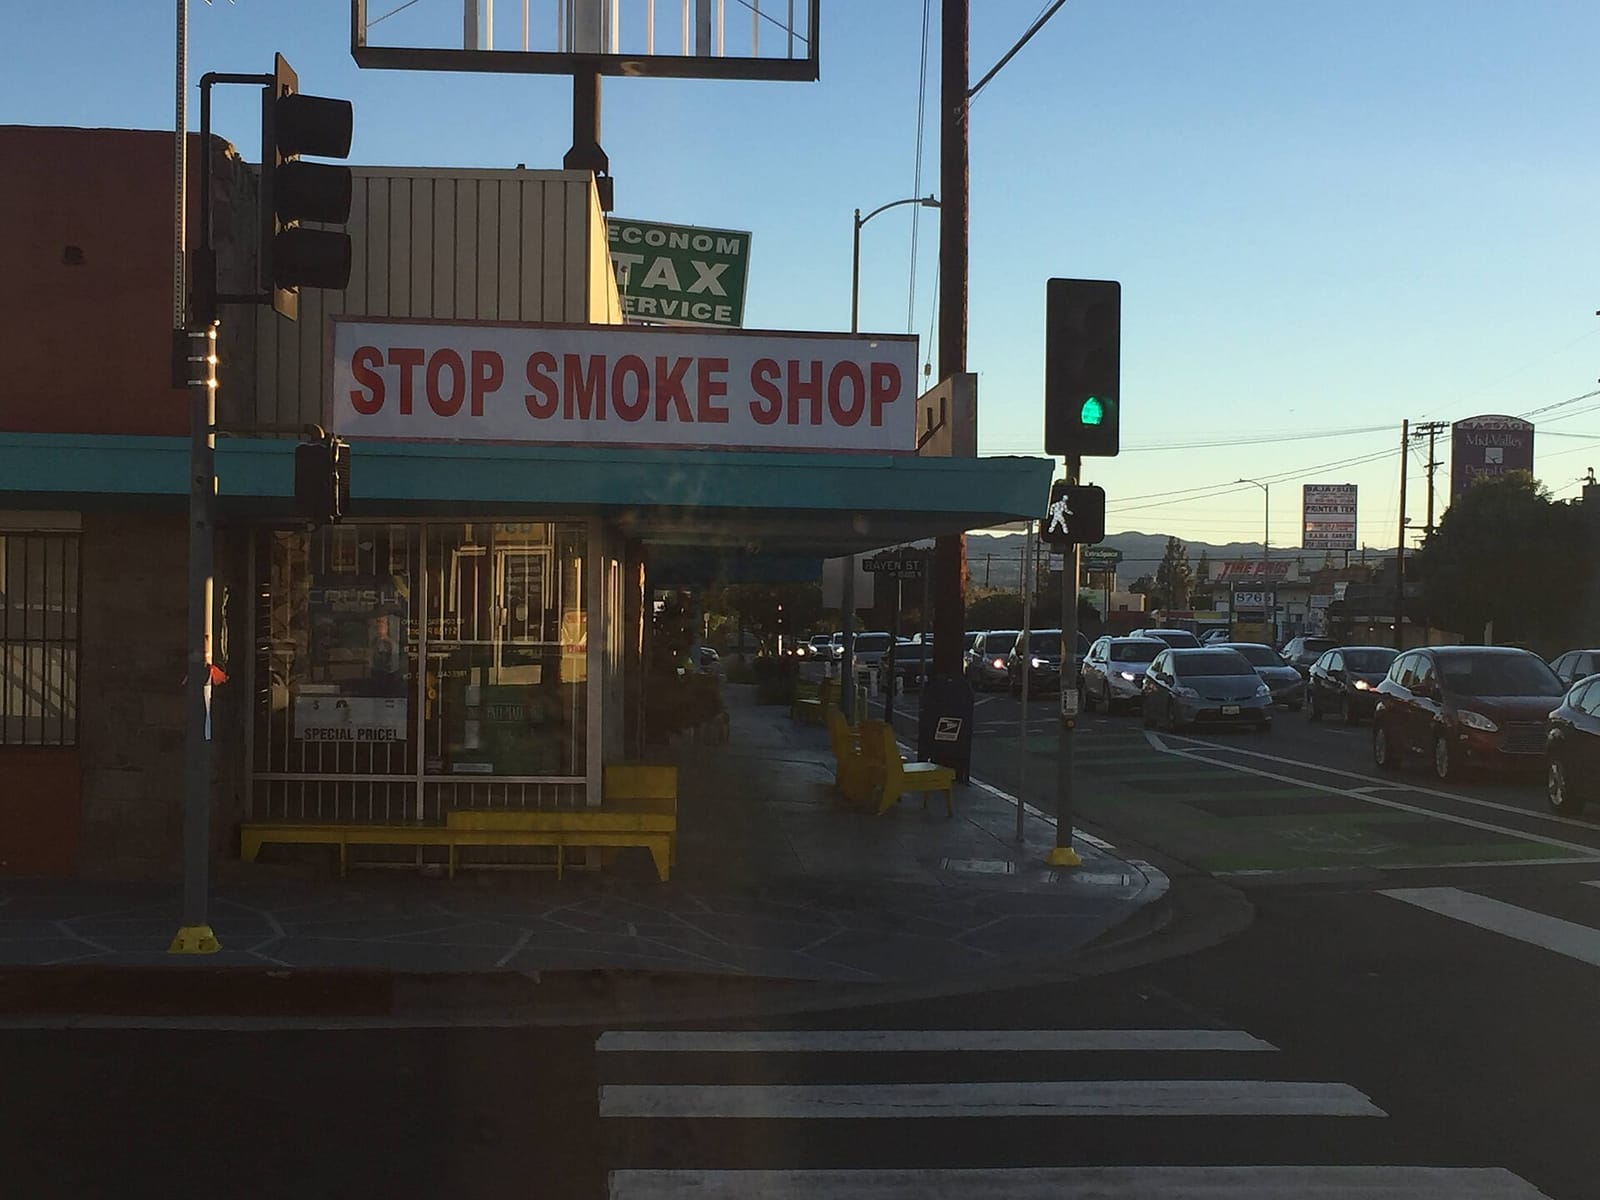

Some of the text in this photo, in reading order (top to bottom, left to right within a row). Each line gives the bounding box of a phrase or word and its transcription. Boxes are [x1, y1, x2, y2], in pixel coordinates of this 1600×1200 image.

[608, 224, 740, 255] ECONOM
[611, 251, 731, 297] TAX
[620, 294, 732, 322] ERVICE
[350, 346, 901, 427] STOP SMOKE SHOP
[905, 560, 920, 571] ST
[303, 728, 398, 741] SPECIAL PRICE!
